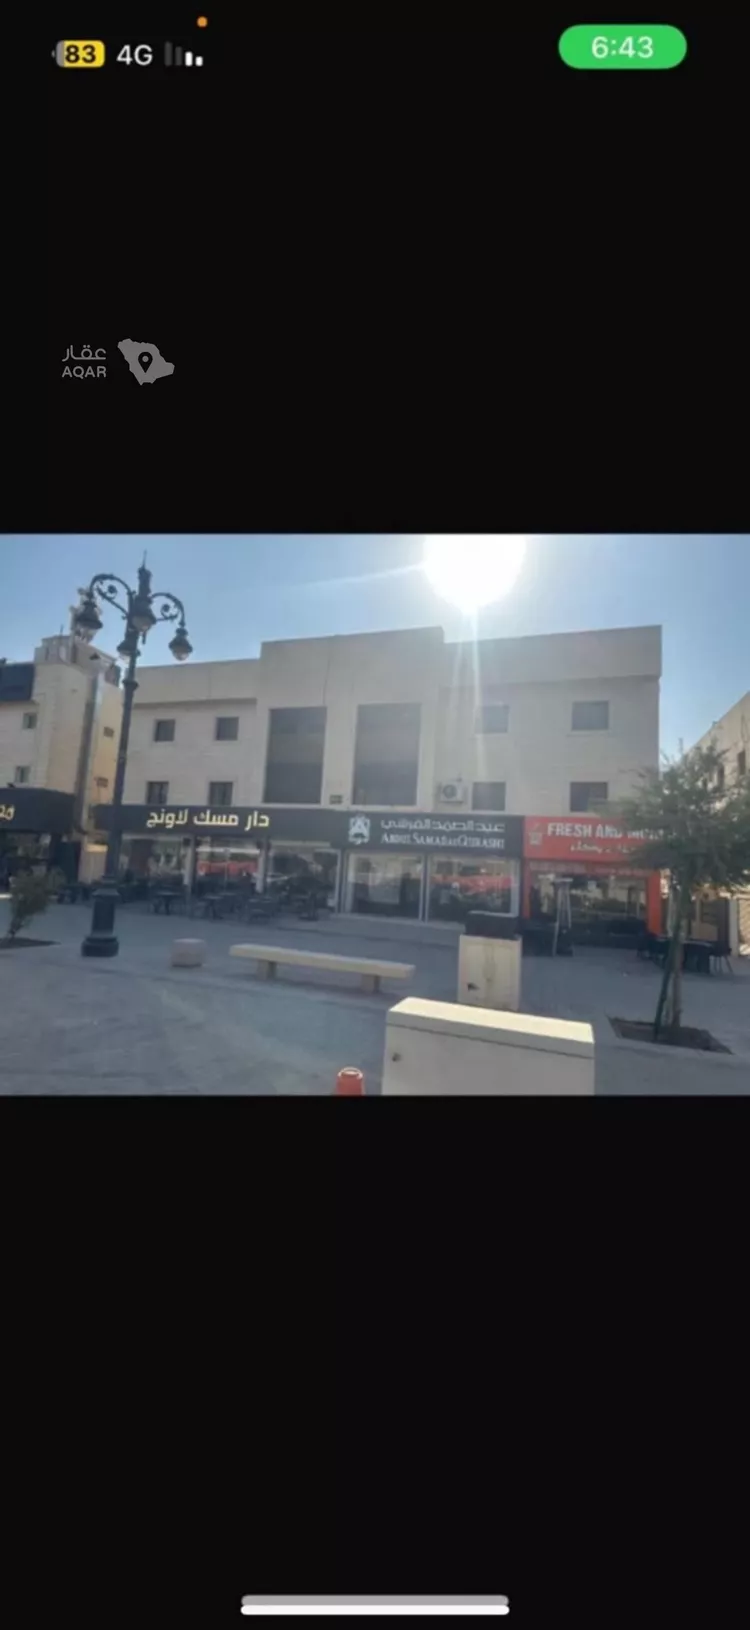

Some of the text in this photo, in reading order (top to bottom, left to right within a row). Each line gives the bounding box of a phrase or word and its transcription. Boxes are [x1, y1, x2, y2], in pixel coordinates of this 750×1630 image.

[146, 808, 270, 831] دار مسك لاونج
[475, 822, 506, 833] عبد
[547, 822, 592, 838] FRESH
[595, 823, 623, 839] AND
